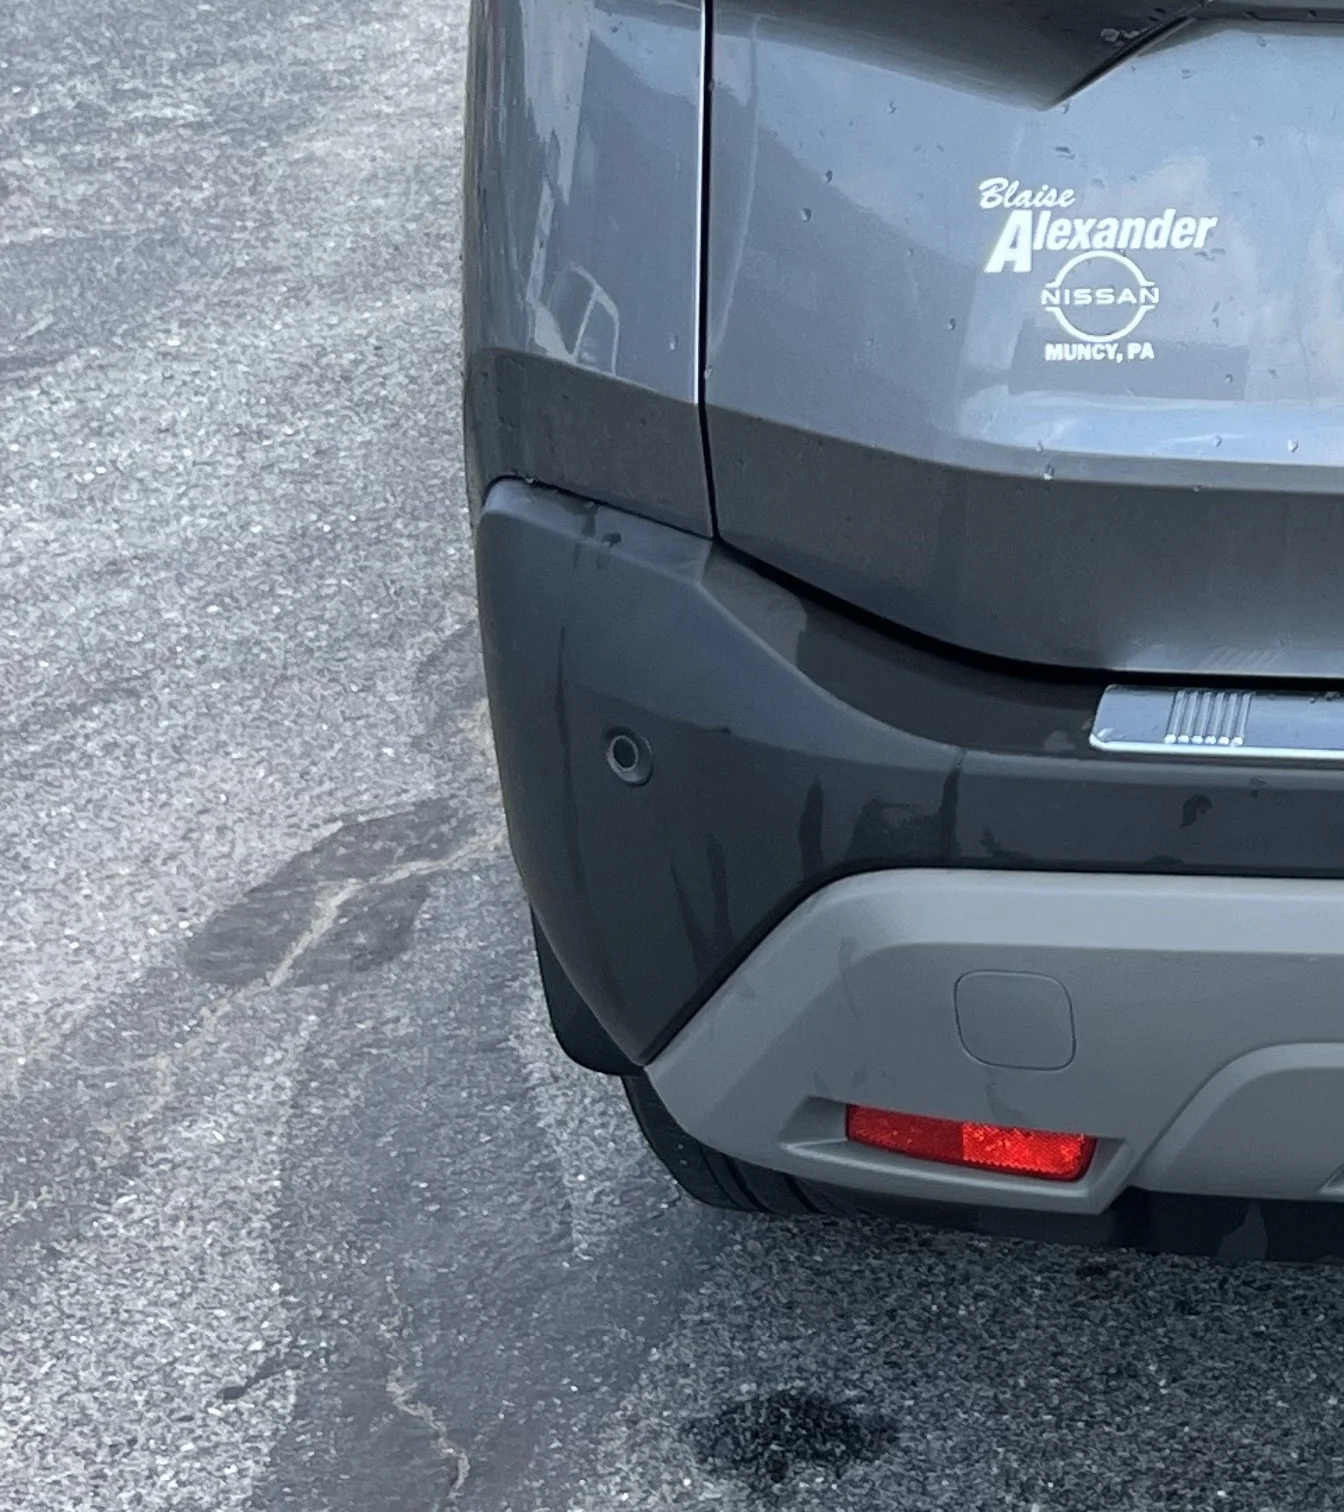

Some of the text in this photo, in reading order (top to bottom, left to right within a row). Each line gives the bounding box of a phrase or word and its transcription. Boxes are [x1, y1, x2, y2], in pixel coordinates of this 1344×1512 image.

[978, 177, 1076, 209] Blaise
[983, 208, 1218, 273] Alexander
[1040, 288, 1160, 306] NISSAN
[1045, 343, 1155, 363] MUNCY, PA
